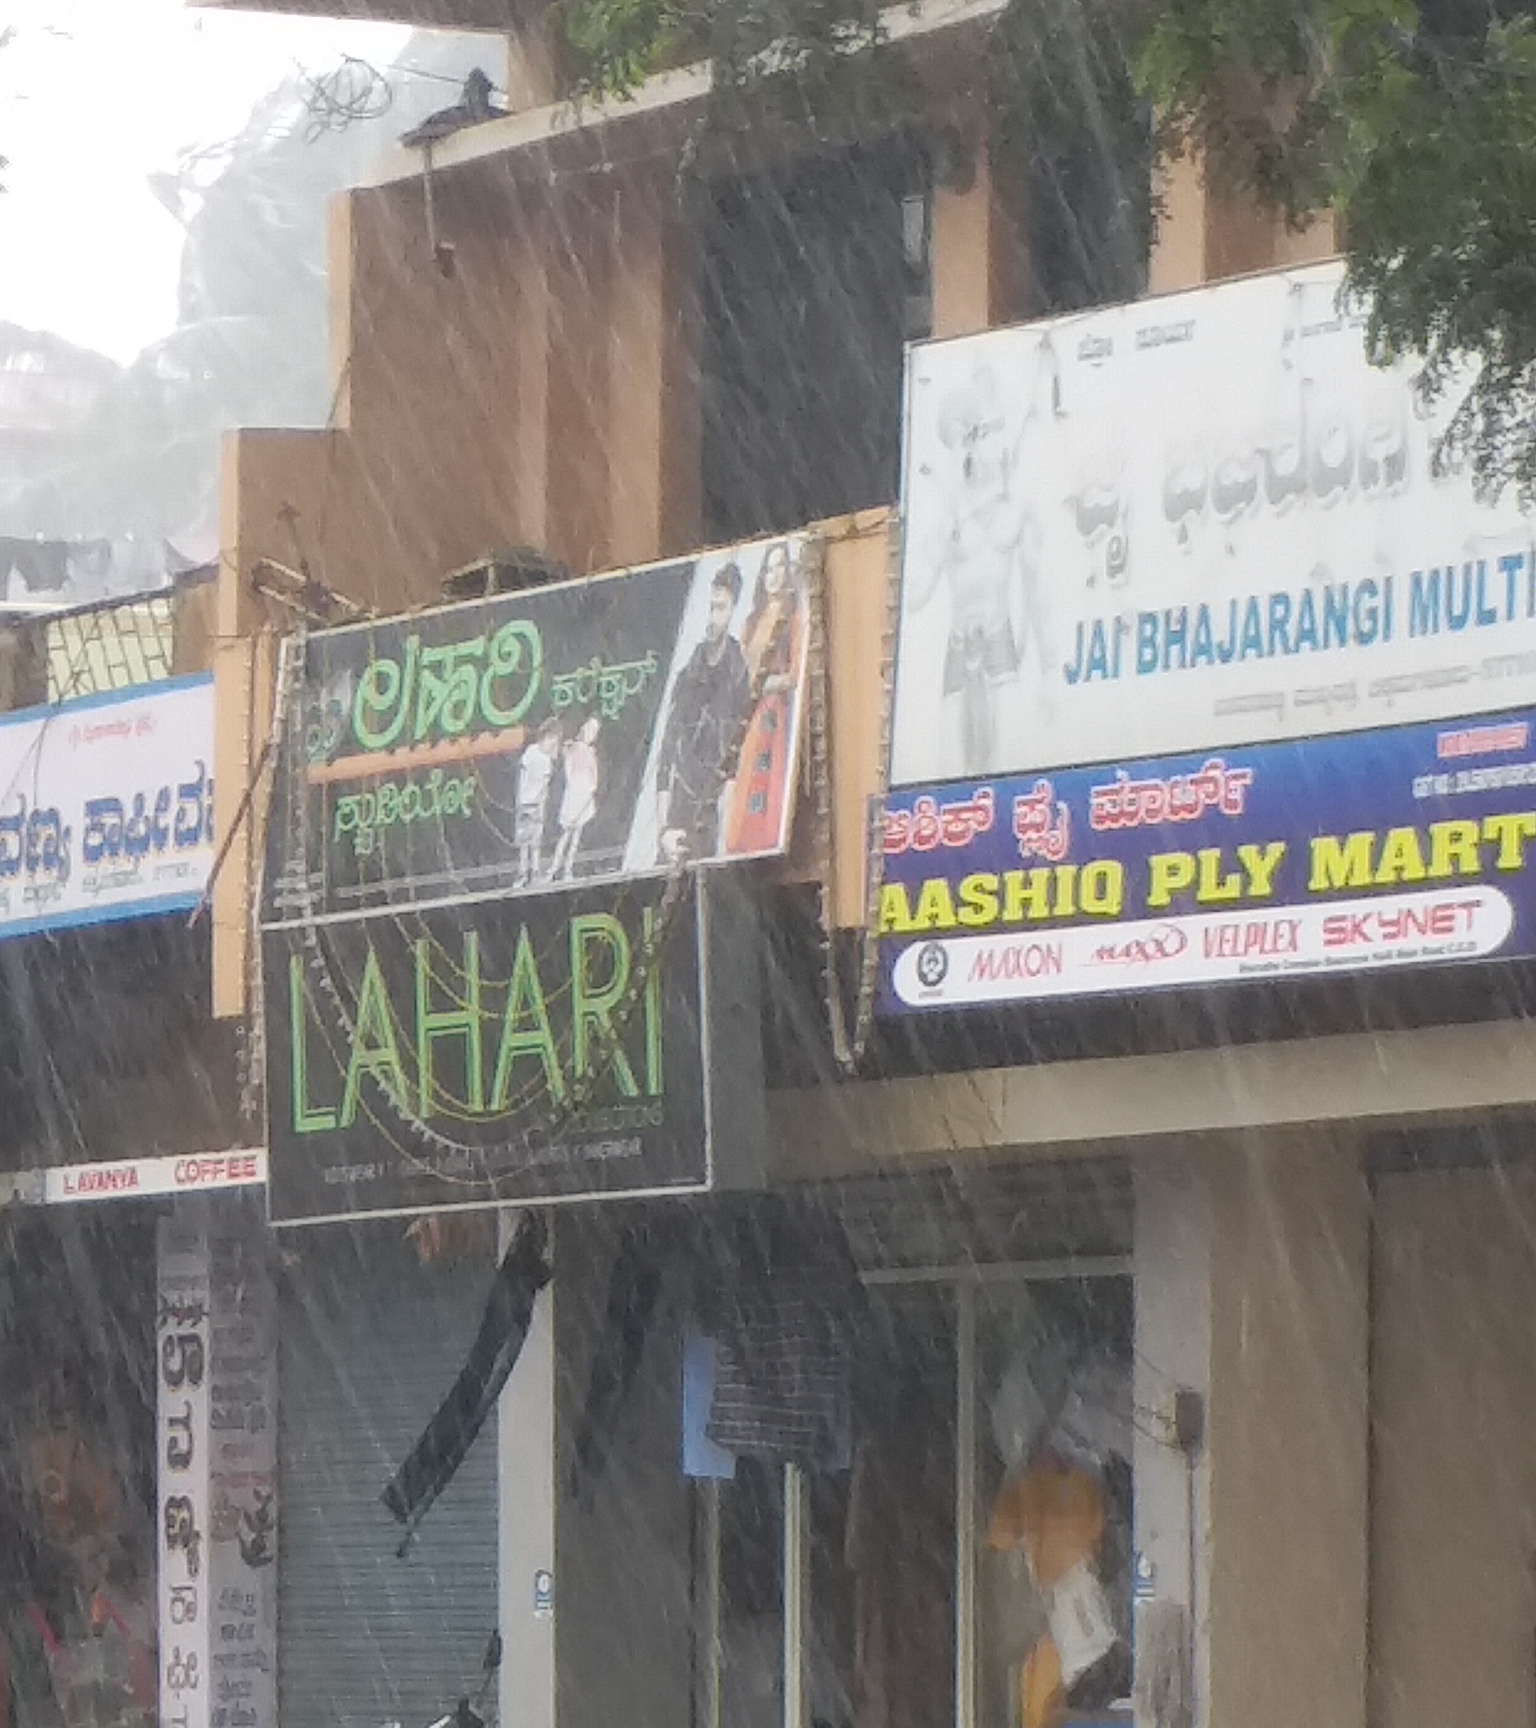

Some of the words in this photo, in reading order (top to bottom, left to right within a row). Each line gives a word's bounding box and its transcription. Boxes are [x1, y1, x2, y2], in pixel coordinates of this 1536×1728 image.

[1062, 616, 1128, 685] JAI
[1136, 574, 1394, 676] BHAJARANGI
[879, 860, 1123, 934] AASHIQ
[1148, 842, 1287, 907] PLY
[1308, 811, 1536, 893] MART
[968, 941, 1063, 982] MAXON
[1203, 918, 1302, 960] VELPLEX
[1323, 900, 1484, 947] SKYNET
[290, 906, 665, 1133] LAHARI
[63, 1166, 140, 1195] LAVANYA
[174, 1155, 257, 1186] COFFEE
